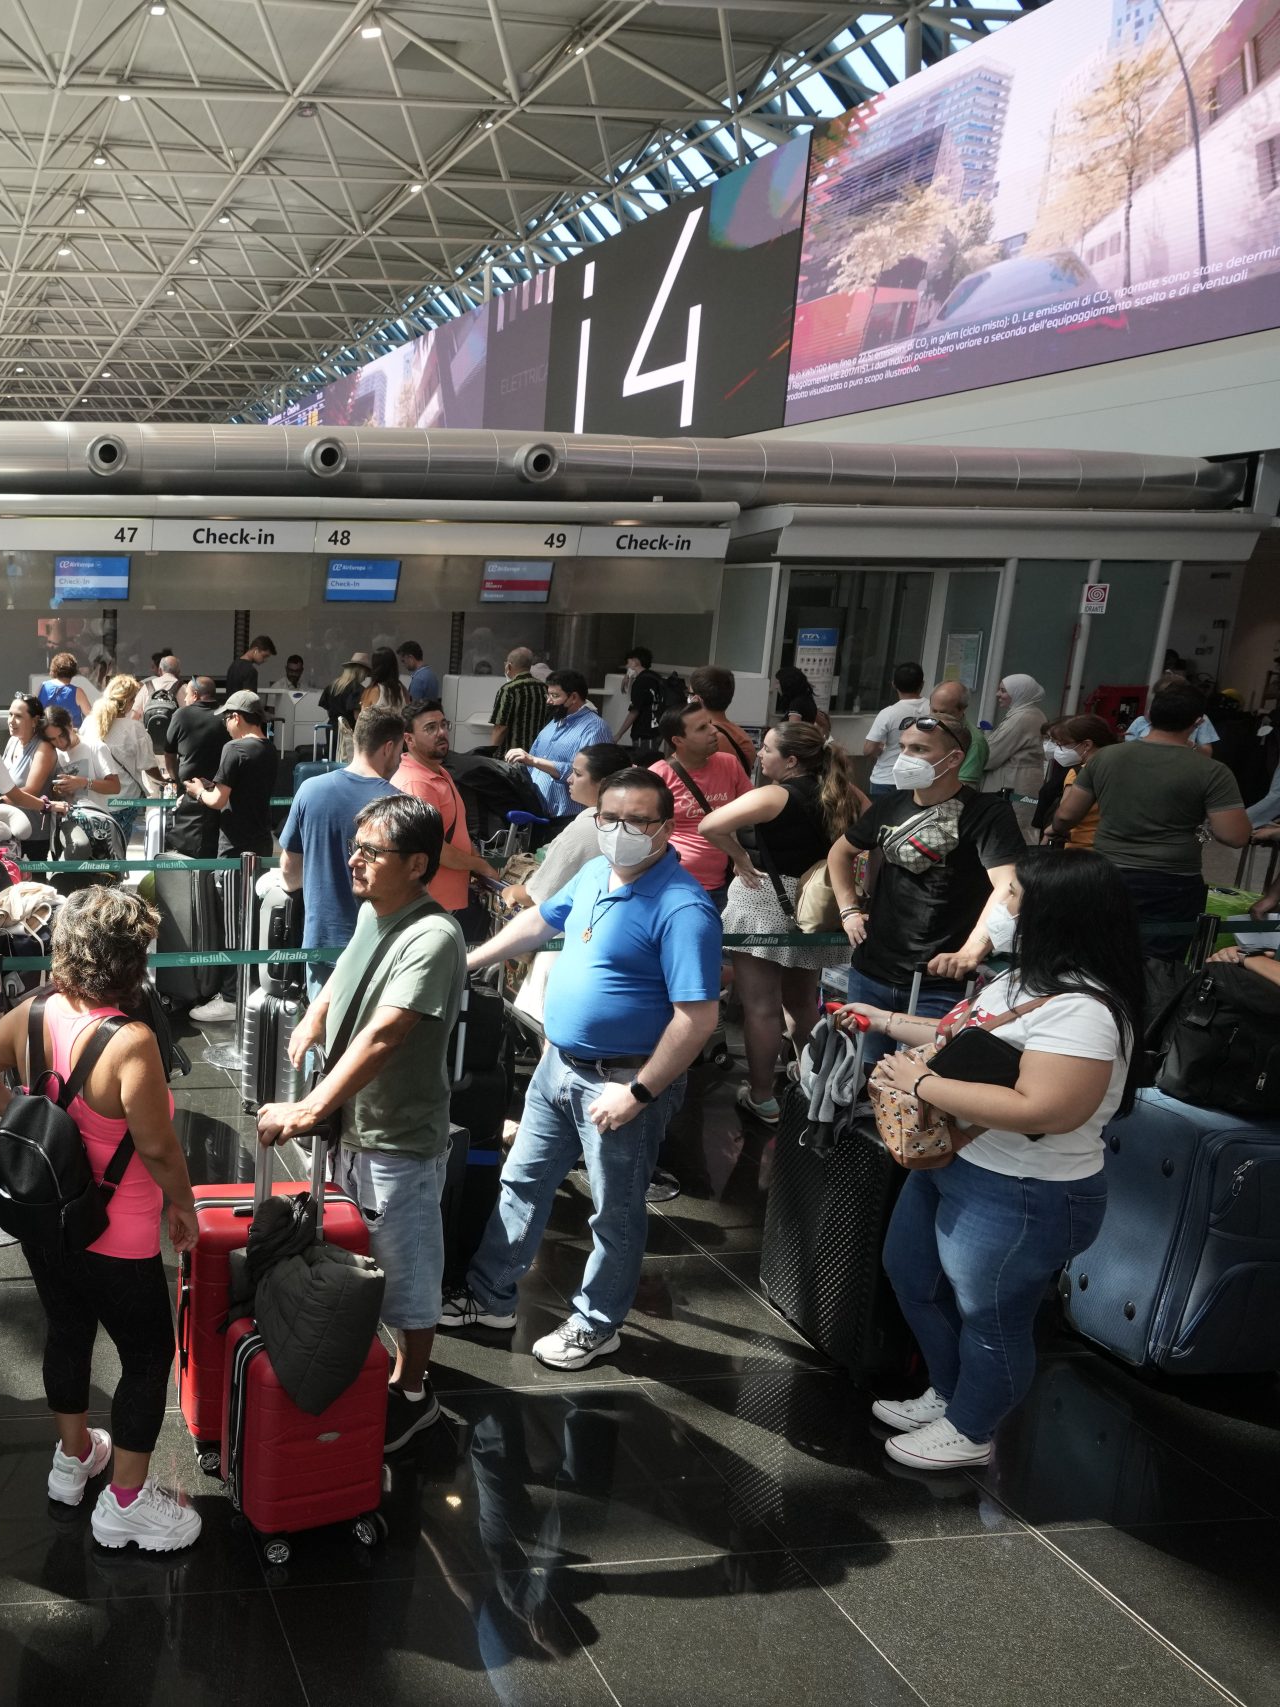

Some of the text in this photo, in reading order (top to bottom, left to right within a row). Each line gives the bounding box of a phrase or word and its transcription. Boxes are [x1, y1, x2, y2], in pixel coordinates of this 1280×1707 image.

[930, 335, 938, 346] in
[938, 329, 959, 344] g/km
[960, 323, 980, 339] (ciclo
[1022, 309, 1035, 322] Le
[1035, 297, 1080, 319] emissioni
[1081, 294, 1092, 307] di
[1114, 278, 1159, 300] riportate
[1161, 271, 1190, 286] sono
[1192, 261, 1224, 279] state
[875, 357, 888, 370] dati
[888, 352, 913, 367] indicati
[913, 342, 955, 363] potrebbero
[955, 336, 982, 350] variare
[991, 325, 1028, 342] seconda
[1134, 290, 1167, 308] scelto
[1168, 288, 1177, 298] e
[1179, 282, 1191, 297] di
[1192, 268, 1249, 293] eventuali
[848, 377, 863, 389] puro
[864, 372, 884, 385] scopo
[885, 364, 921, 380] illustrativo.
[114, 526, 138, 543] 47
[192, 527, 275, 545] Check-in
[327, 529, 351, 546] 48
[543, 533, 567, 549] 49
[614, 534, 691, 552] Check-in
[77, 861, 110, 870] Alitalia
[741, 934, 779, 945] Alitalia
[267, 949, 308, 961] Alitalia
